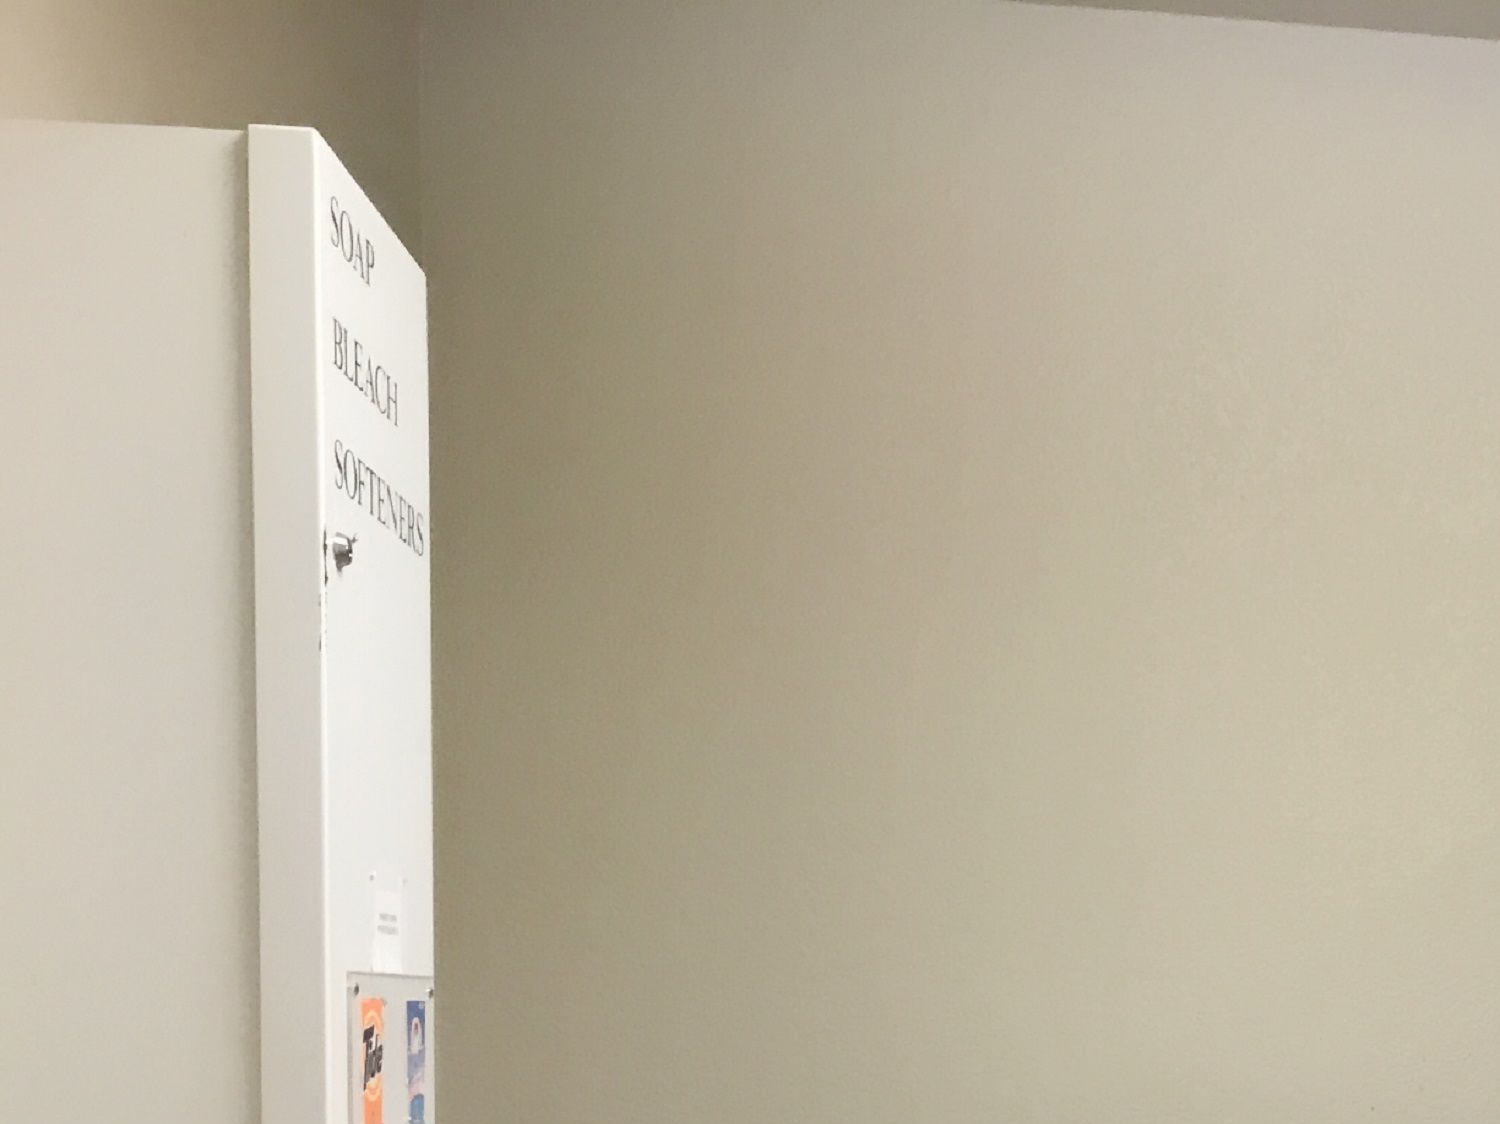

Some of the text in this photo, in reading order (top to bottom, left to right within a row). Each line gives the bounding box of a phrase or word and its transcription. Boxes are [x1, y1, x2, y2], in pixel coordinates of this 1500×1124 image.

[330, 196, 375, 286] SOAP
[333, 317, 399, 427] BLEACH
[334, 439, 425, 557] SOFTENERS
